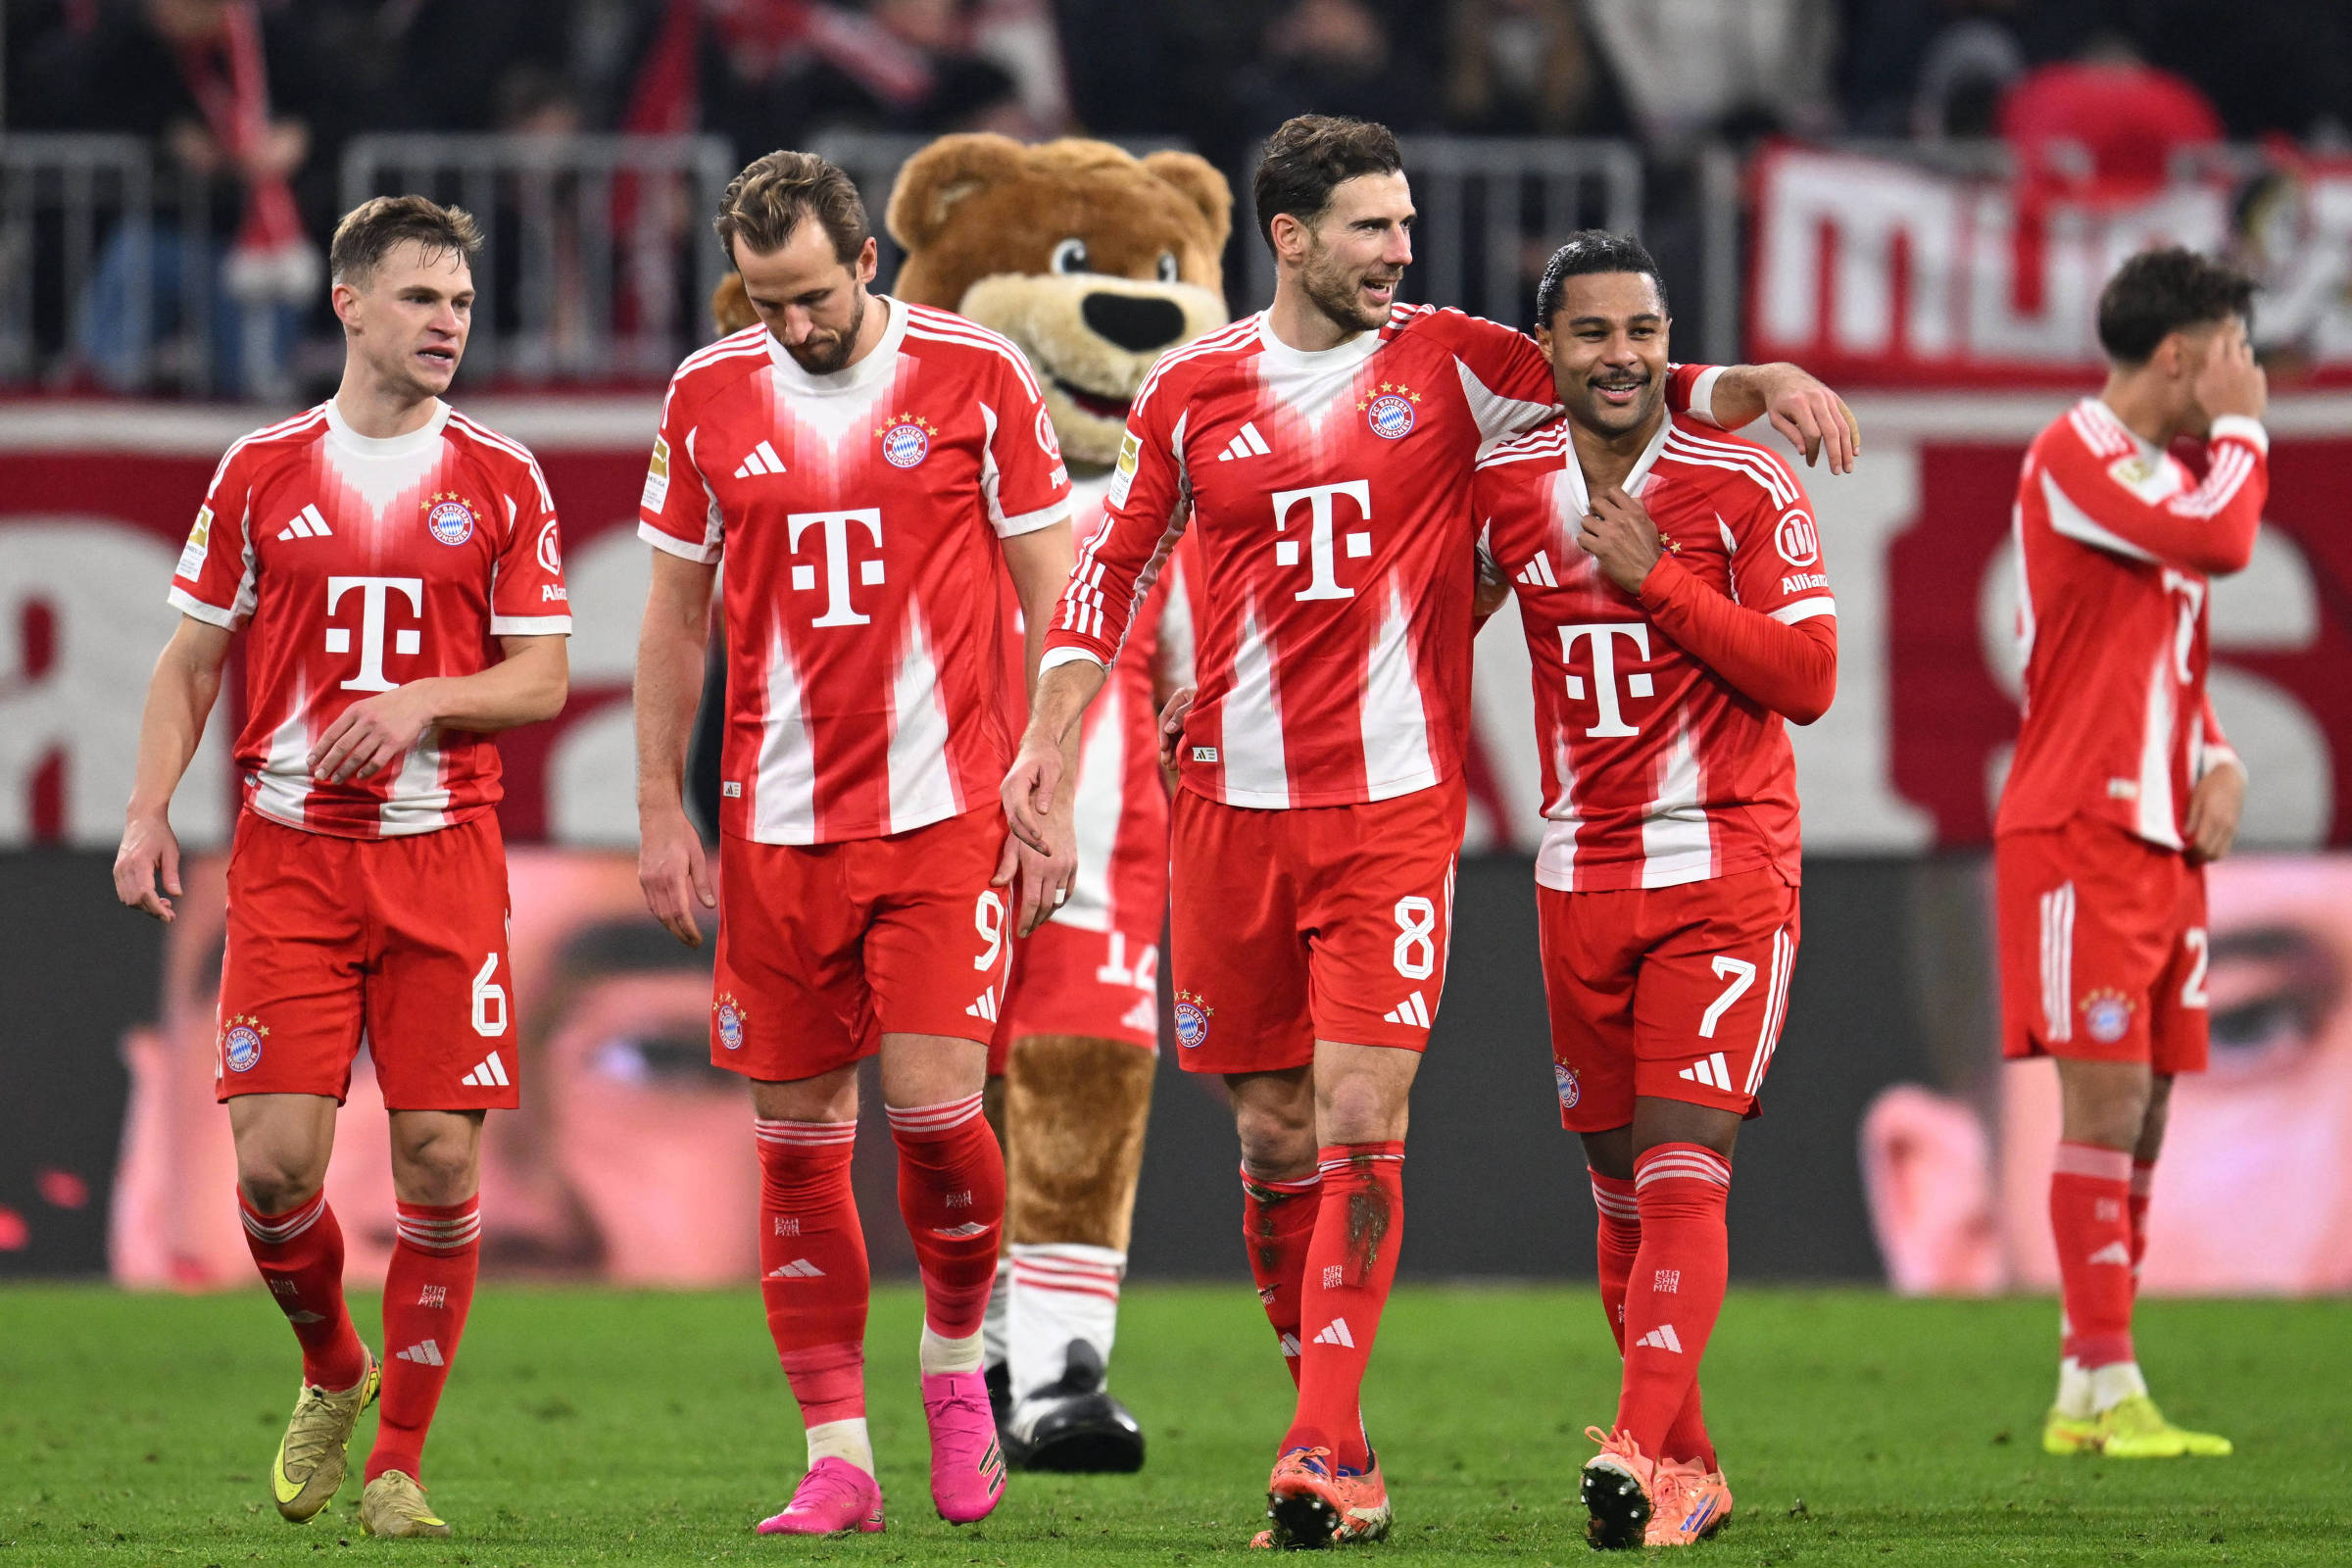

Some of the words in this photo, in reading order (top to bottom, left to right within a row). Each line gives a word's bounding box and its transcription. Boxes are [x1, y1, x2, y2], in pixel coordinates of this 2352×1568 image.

[1379, 399, 1409, 414] BAYERN
[896, 427, 924, 444] BAYERN
[1373, 419, 1411, 437] MÜNCHEN
[442, 506, 470, 524] BAYERN
[1271, 479, 1372, 602] T
[786, 508, 886, 628] T
[325, 576, 422, 691] T
[1557, 622, 1655, 738] T
[973, 889, 1005, 972] 9
[1393, 895, 1436, 981] 8
[471, 952, 508, 1037] 6
[1697, 955, 1757, 1039] 7
[1179, 1006, 1203, 1024] BAYERN
[231, 1030, 258, 1046] BAYERN
[1323, 1264, 1343, 1274] MIA
[1323, 1272, 1343, 1282] SAN
[1655, 1269, 1681, 1278] MIA
[1323, 1279, 1343, 1291] MIA
[1653, 1284, 1677, 1295] MIA
[1654, 1277, 1679, 1286] SAN
